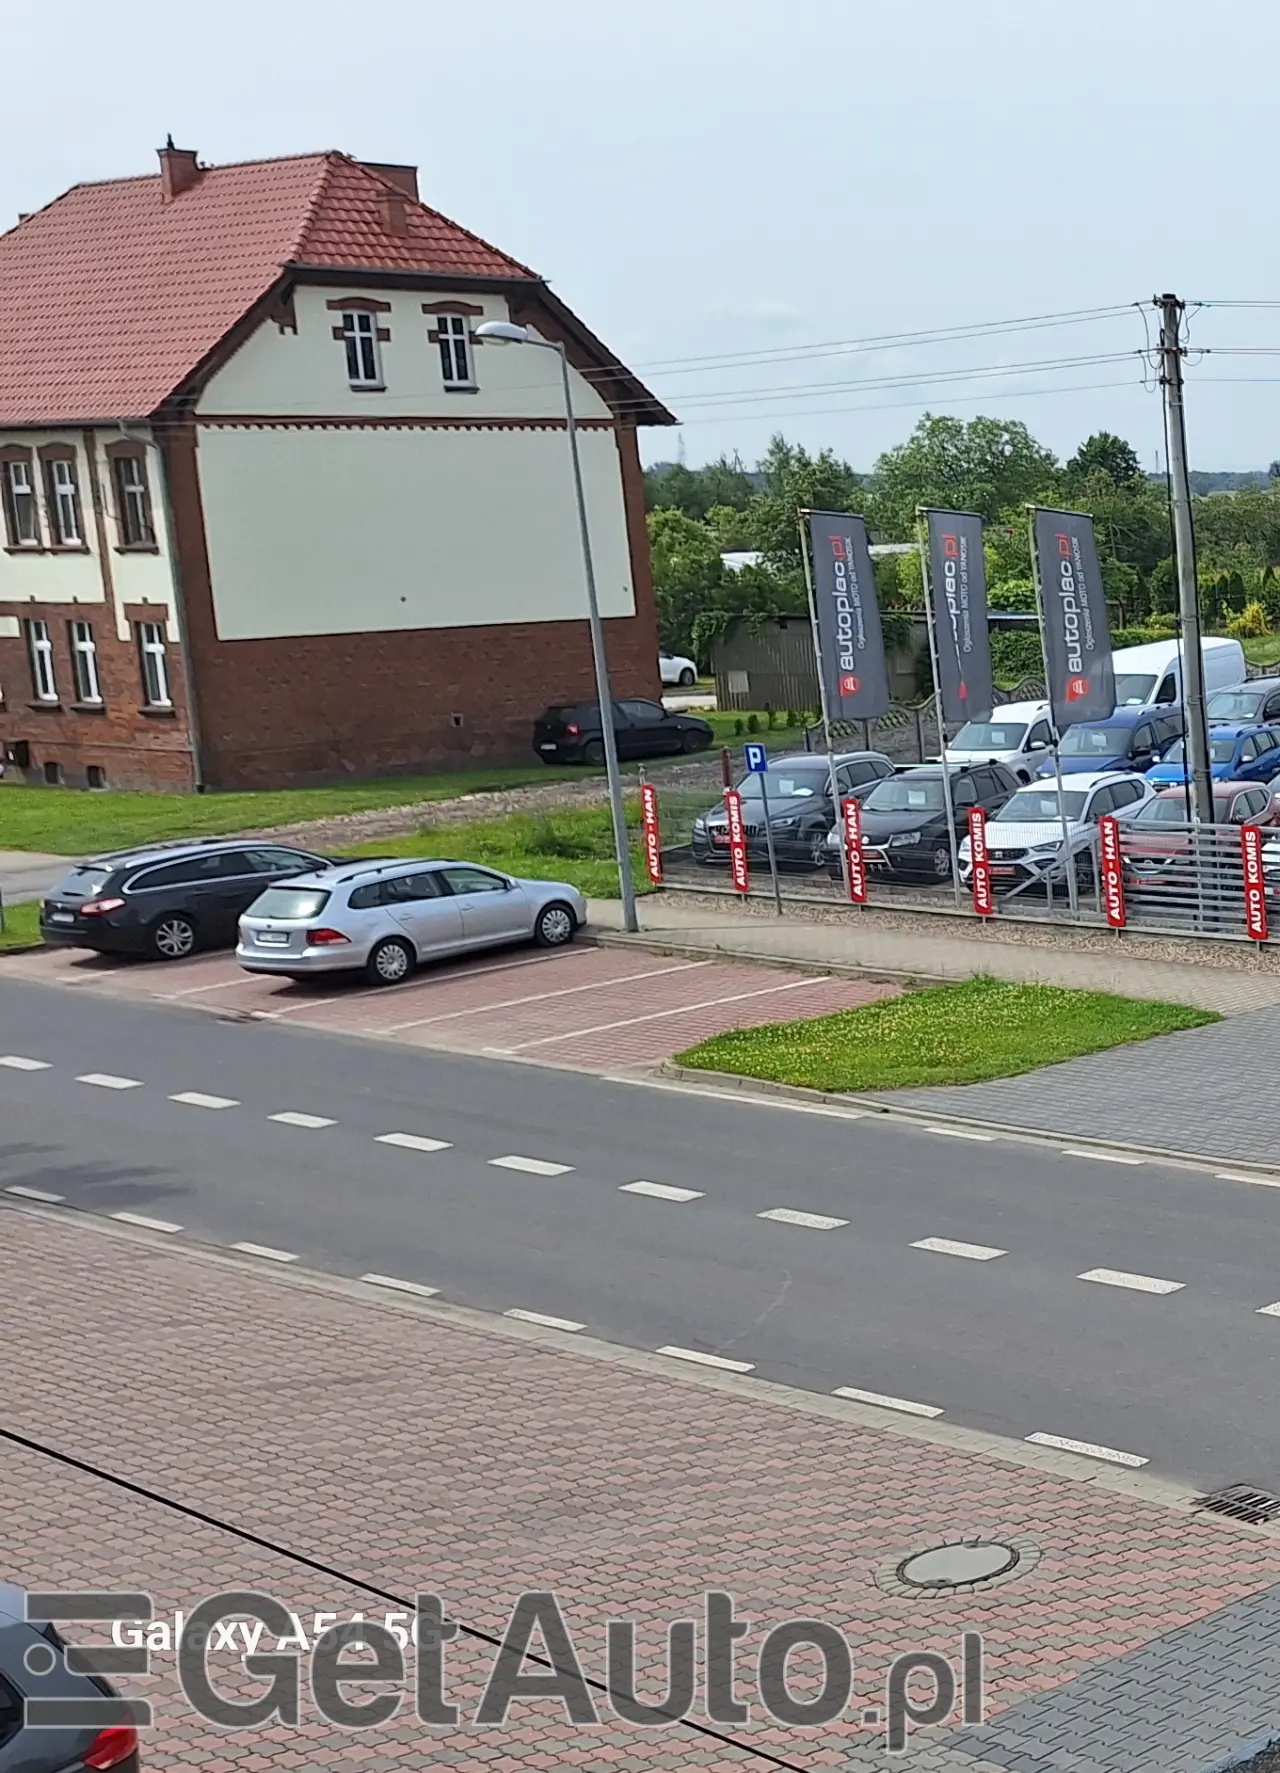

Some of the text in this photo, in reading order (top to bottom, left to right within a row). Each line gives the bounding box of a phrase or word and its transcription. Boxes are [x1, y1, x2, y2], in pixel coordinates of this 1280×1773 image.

[850, 571, 858, 582] od
[961, 572, 968, 583] od
[1076, 571, 1085, 582] od
[829, 535, 854, 671] autoplac.pl
[851, 583, 861, 607] MOTO
[943, 534, 963, 674] plac.pl
[960, 584, 969, 609] MOTO
[1054, 533, 1083, 673] autoplac.pl
[1078, 583, 1089, 607] MOTO
[748, 746, 761, 769] P
[729, 795, 746, 887] AUTO KOMIS
[972, 812, 988, 908] AUTO KOMIS
[1245, 831, 1262, 933] AUTO KOMIS
